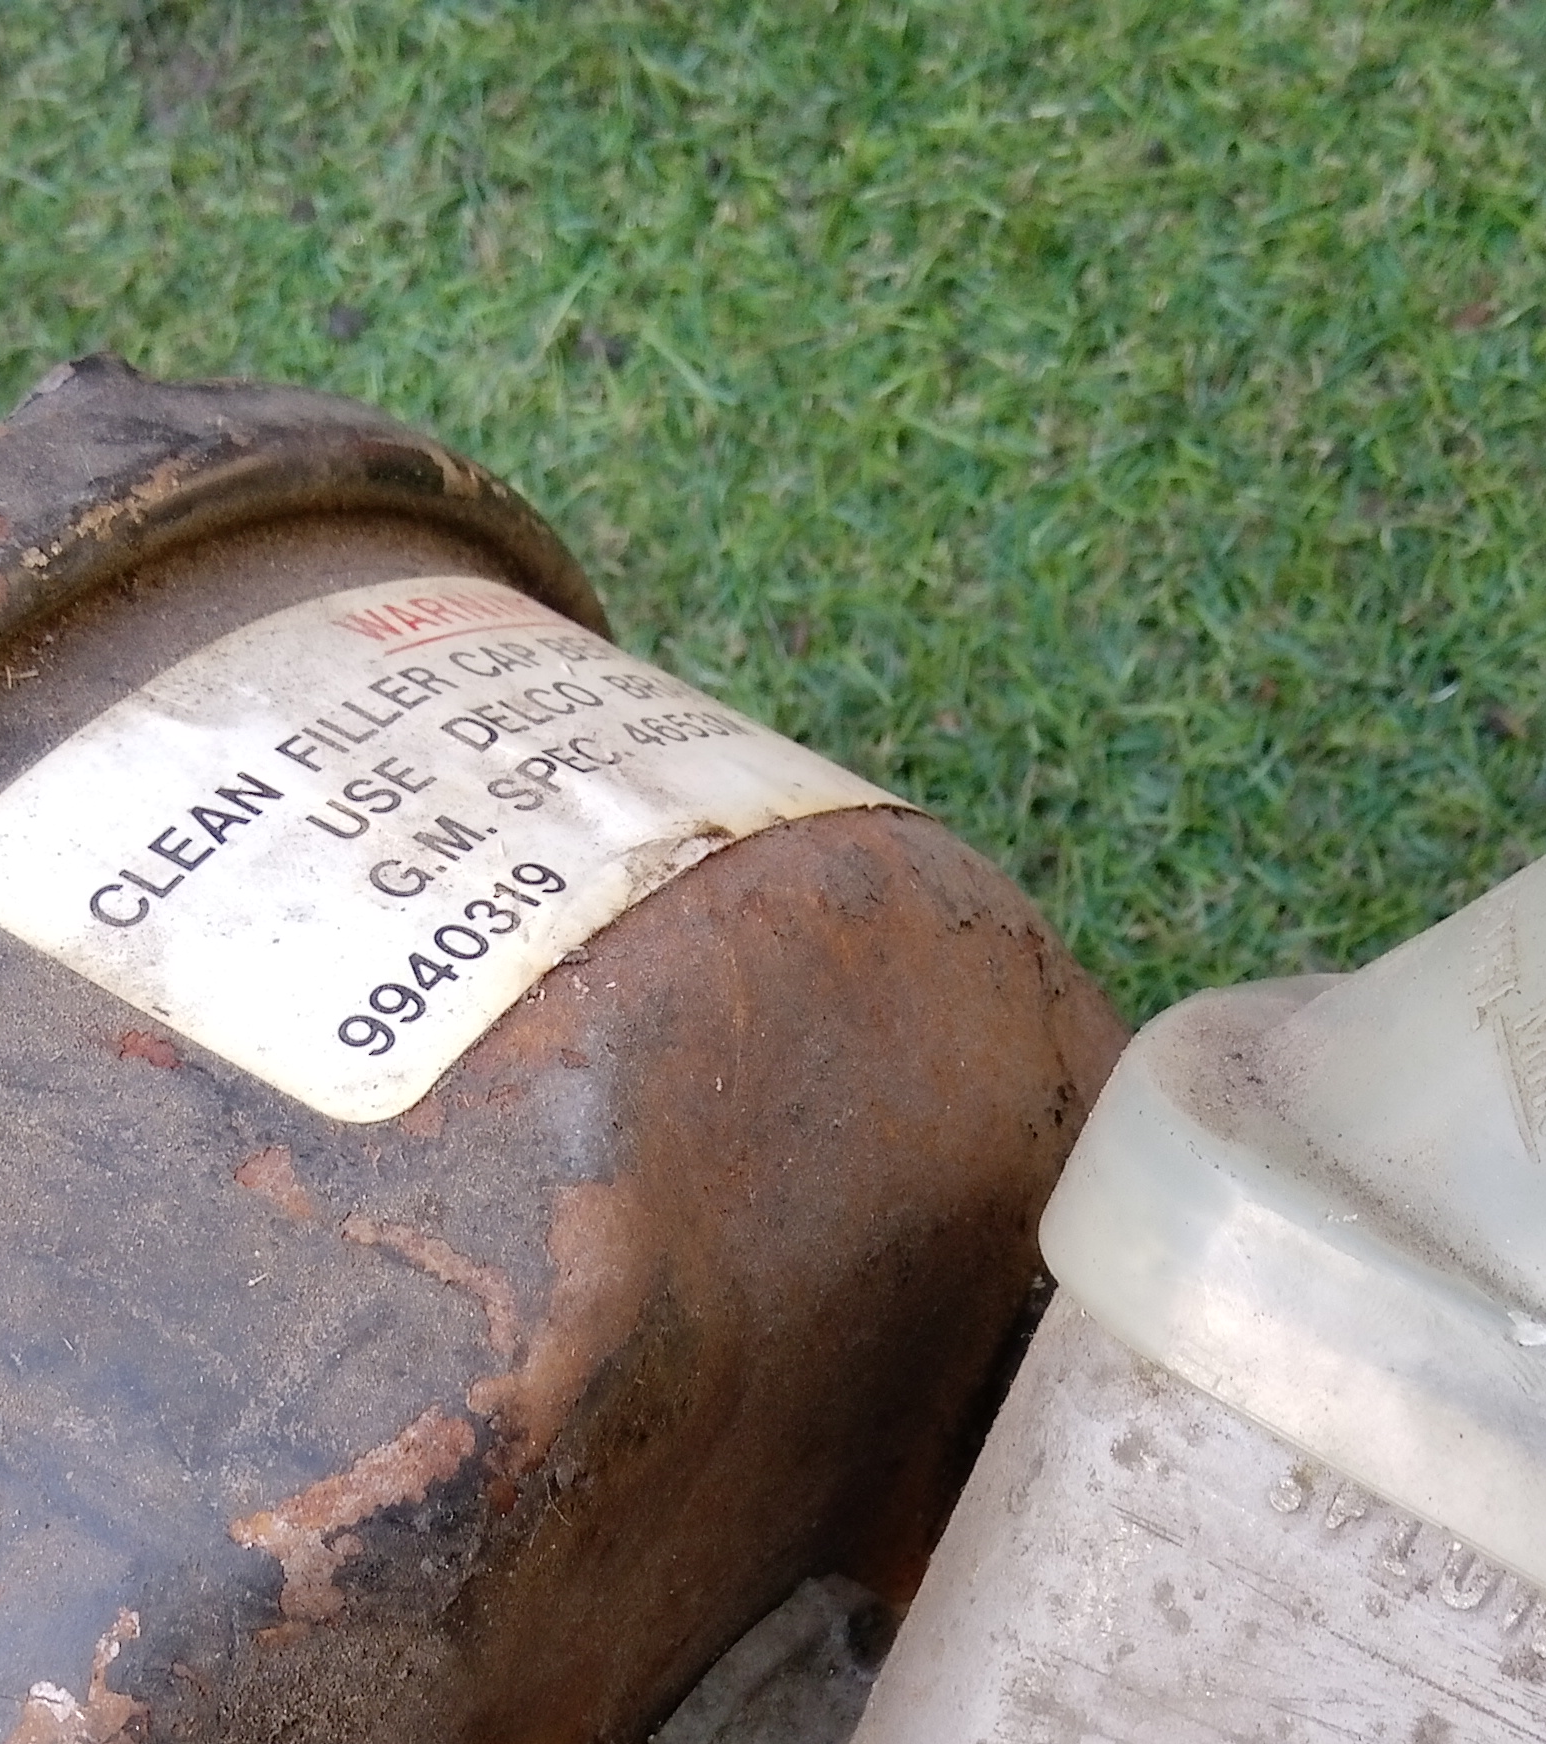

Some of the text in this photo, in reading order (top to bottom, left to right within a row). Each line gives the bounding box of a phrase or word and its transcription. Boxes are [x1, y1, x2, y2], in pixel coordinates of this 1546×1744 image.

[89, 770, 285, 928] CLEAN
[274, 665, 459, 773] FILLER
[448, 641, 542, 678] CAP
[305, 756, 438, 839] USE
[439, 681, 604, 752] DELCO
[368, 814, 498, 897] G.M.
[486, 736, 635, 812] SPEC.
[337, 862, 567, 1057] 9940319
